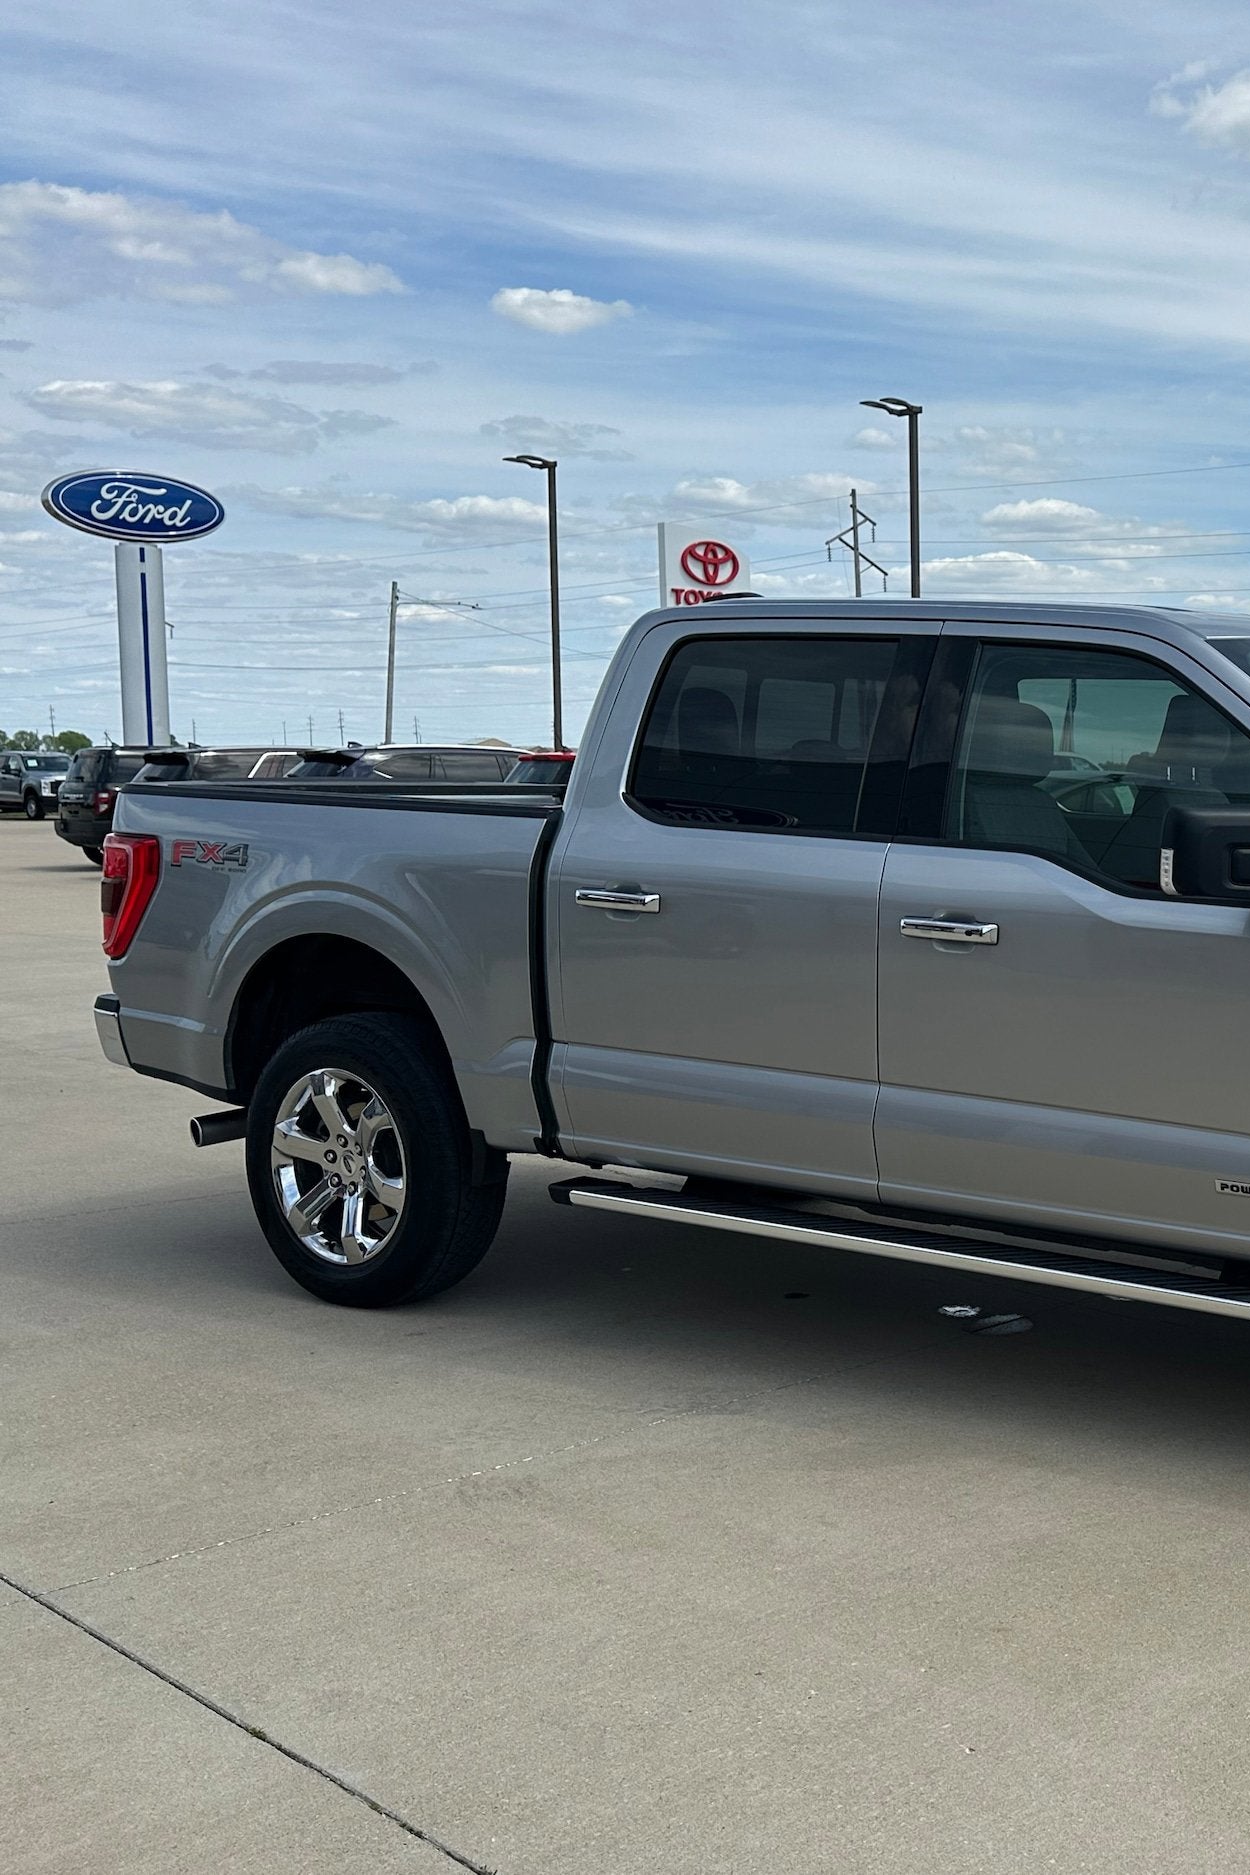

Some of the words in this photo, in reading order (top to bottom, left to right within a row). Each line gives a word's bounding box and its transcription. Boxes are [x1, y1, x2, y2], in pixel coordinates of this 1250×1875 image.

[91, 482, 192, 527] Ford
[671, 588, 724, 606] TOY
[171, 839, 249, 867] FX4
